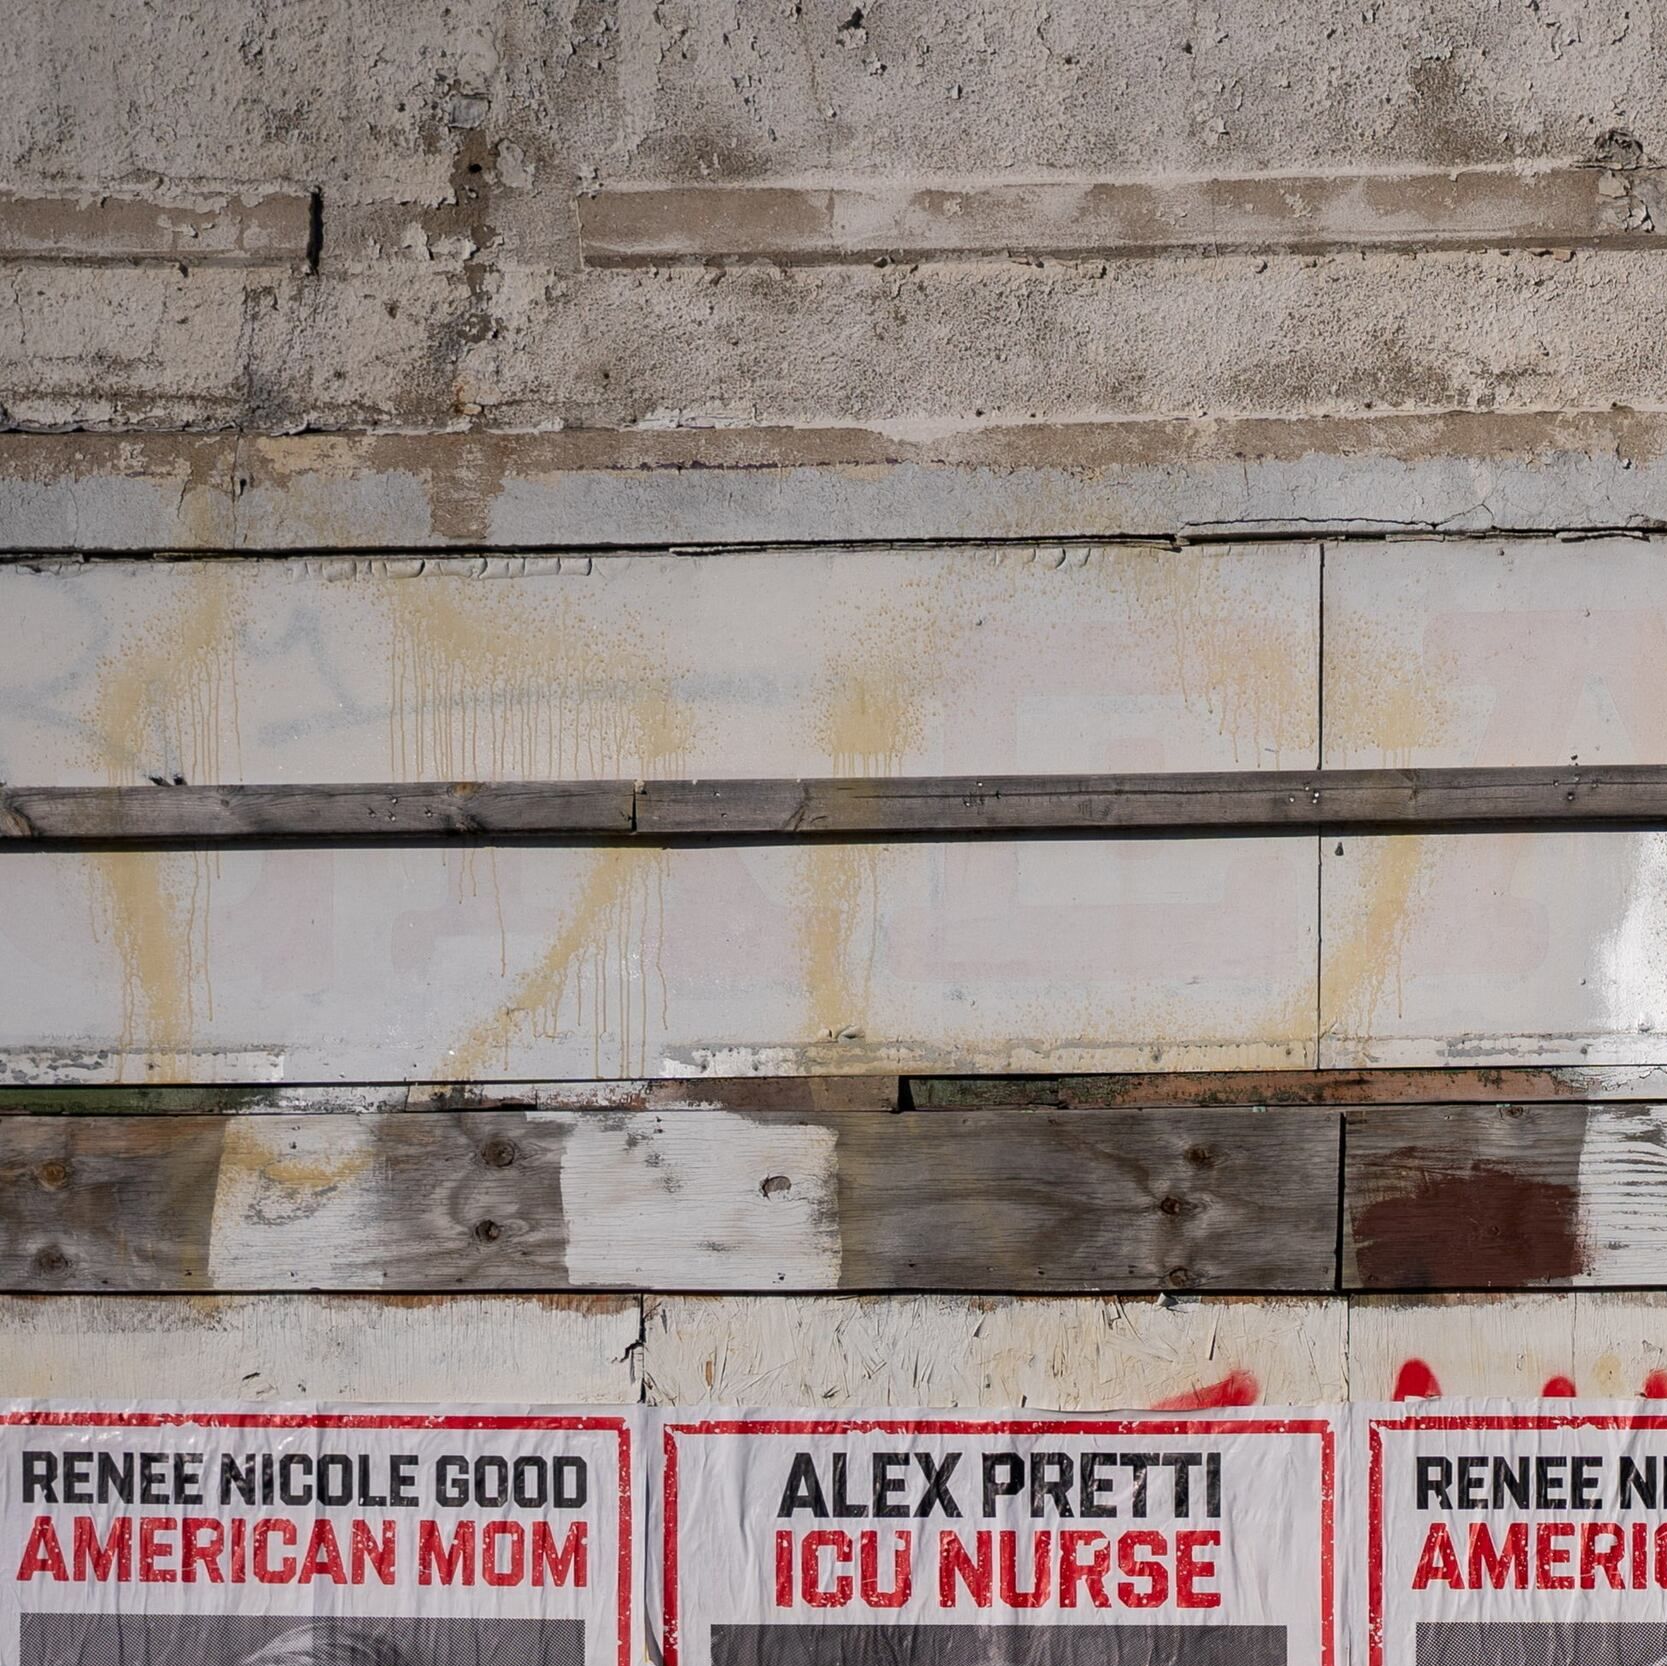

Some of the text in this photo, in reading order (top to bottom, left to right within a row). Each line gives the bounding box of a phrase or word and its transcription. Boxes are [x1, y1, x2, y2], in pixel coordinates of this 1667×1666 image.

[22, 1451, 588, 1509] RENEE NICOLE GOOD
[777, 1452, 1221, 1518] ALEX PRETTI
[1416, 1456, 1603, 1510] RENEE
[16, 1515, 588, 1588] AMERICAN MOM
[775, 1530, 1222, 1609] ICU NURSE
